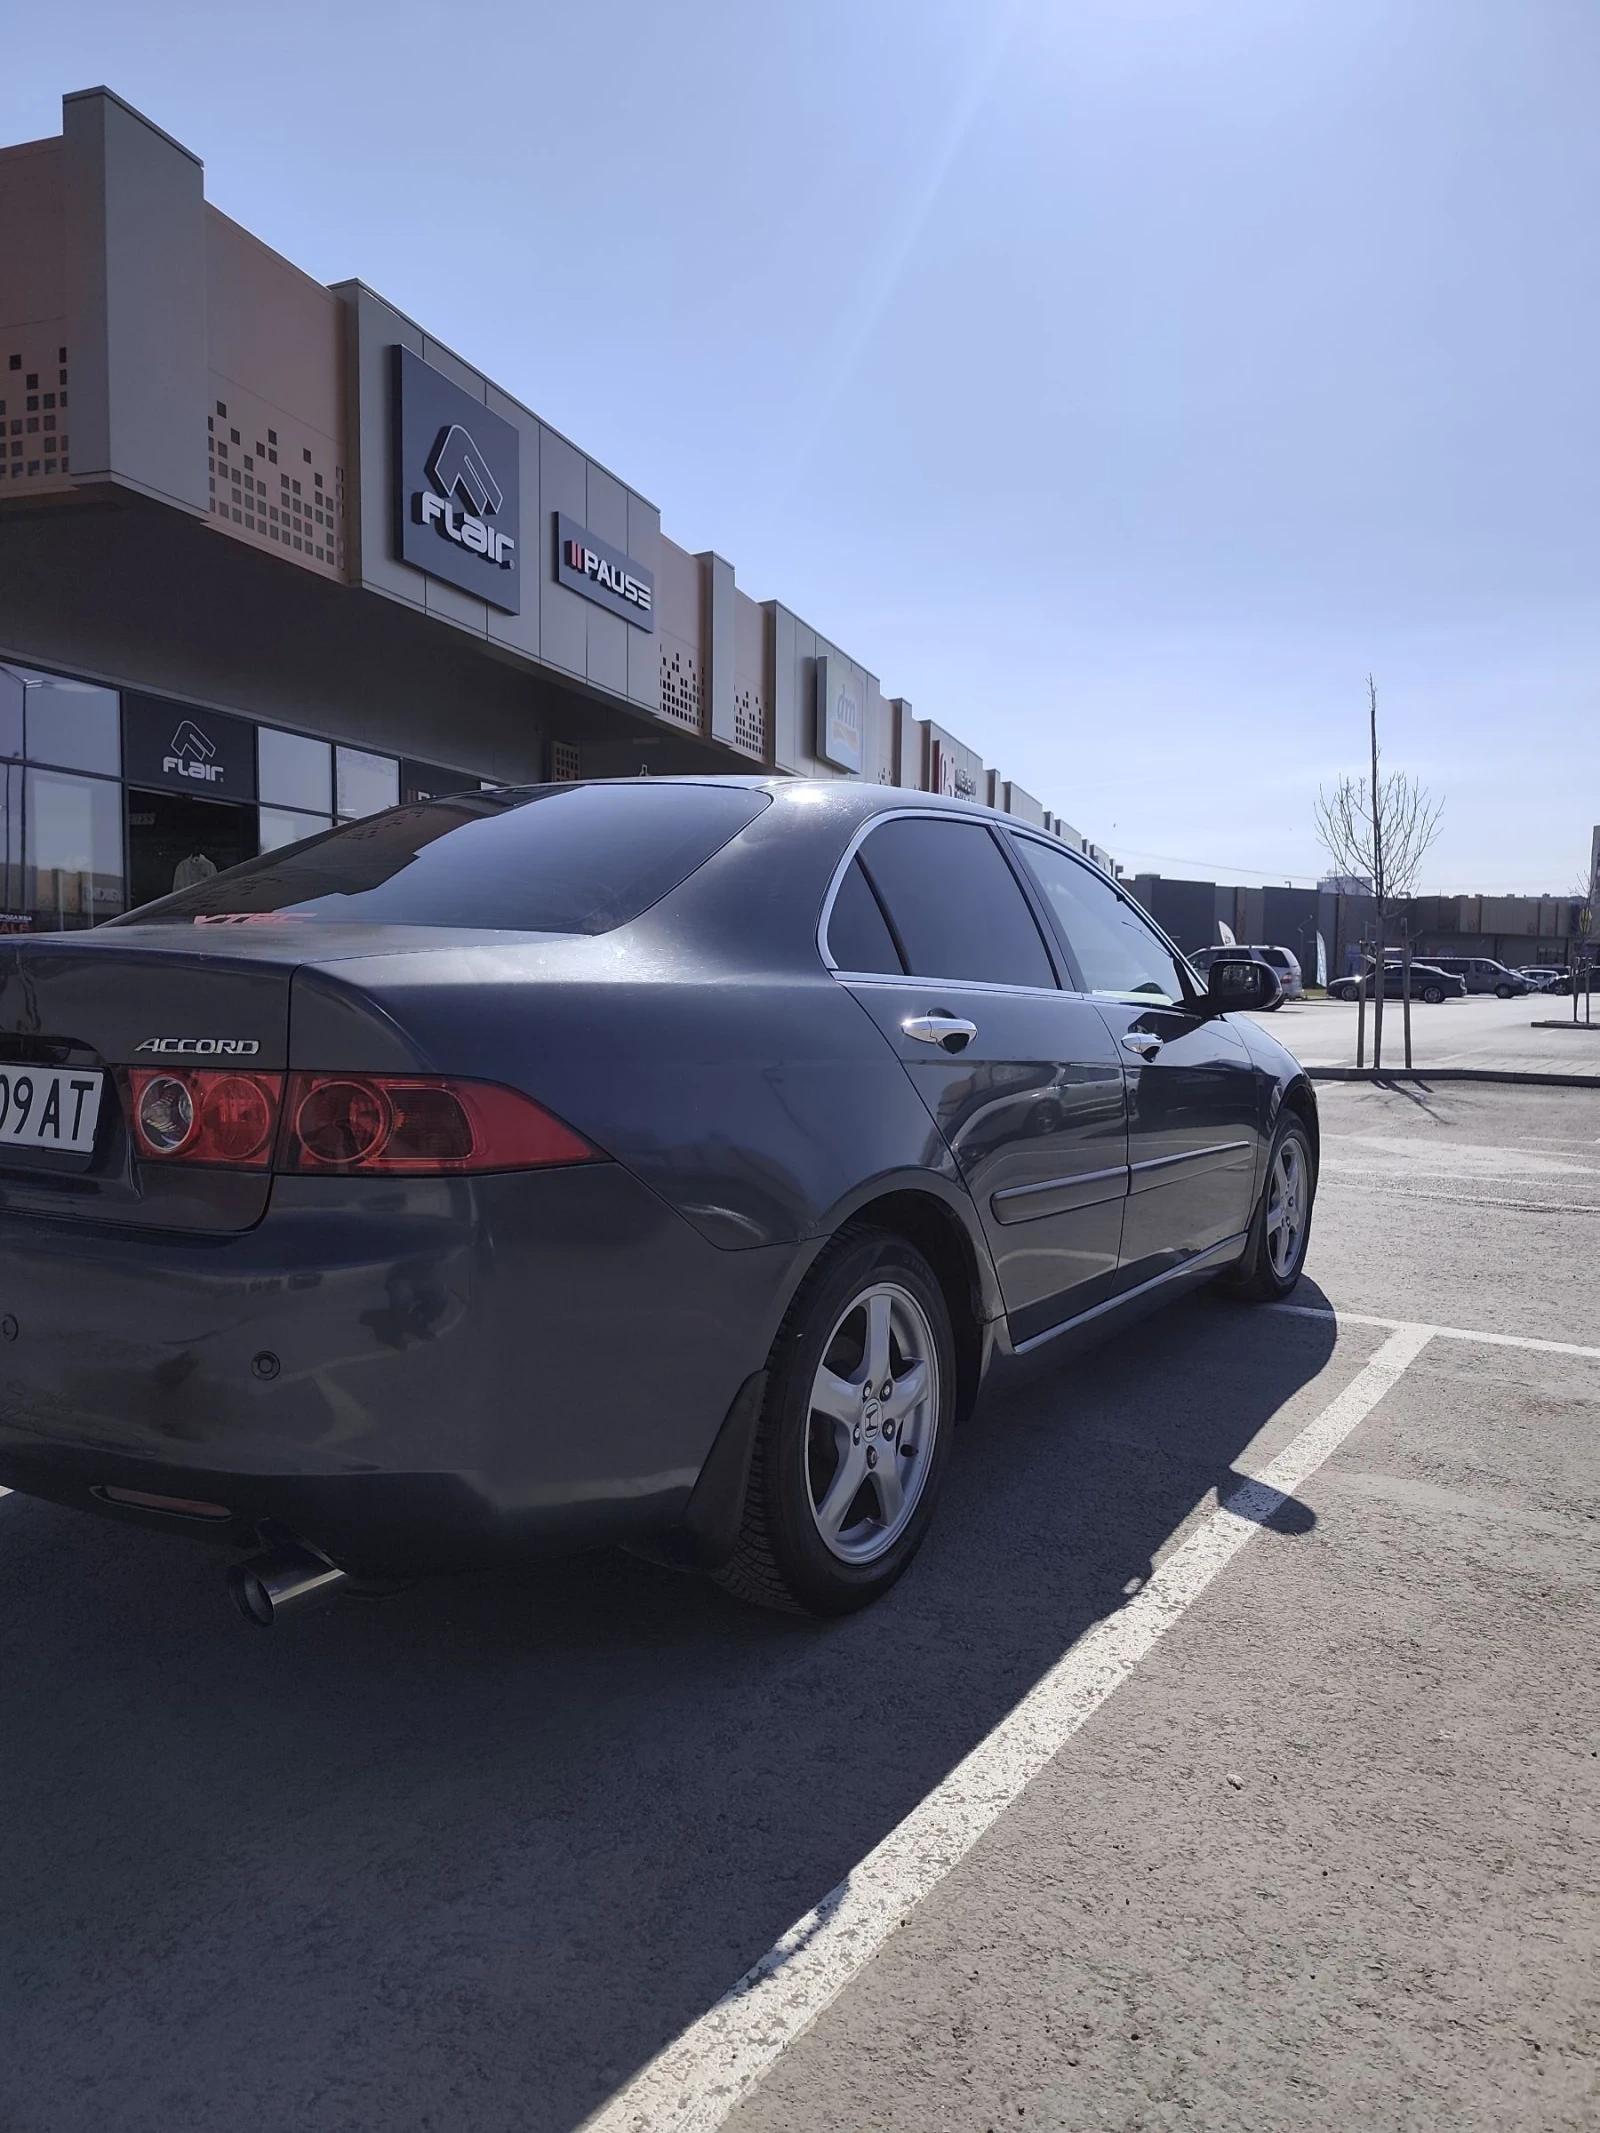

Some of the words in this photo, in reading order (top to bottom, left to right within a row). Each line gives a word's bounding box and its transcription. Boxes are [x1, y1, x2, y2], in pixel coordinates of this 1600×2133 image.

[584, 547, 651, 610] PAUSE
[837, 683, 856, 728] dm
[134, 1037, 260, 1055] ACCORD
